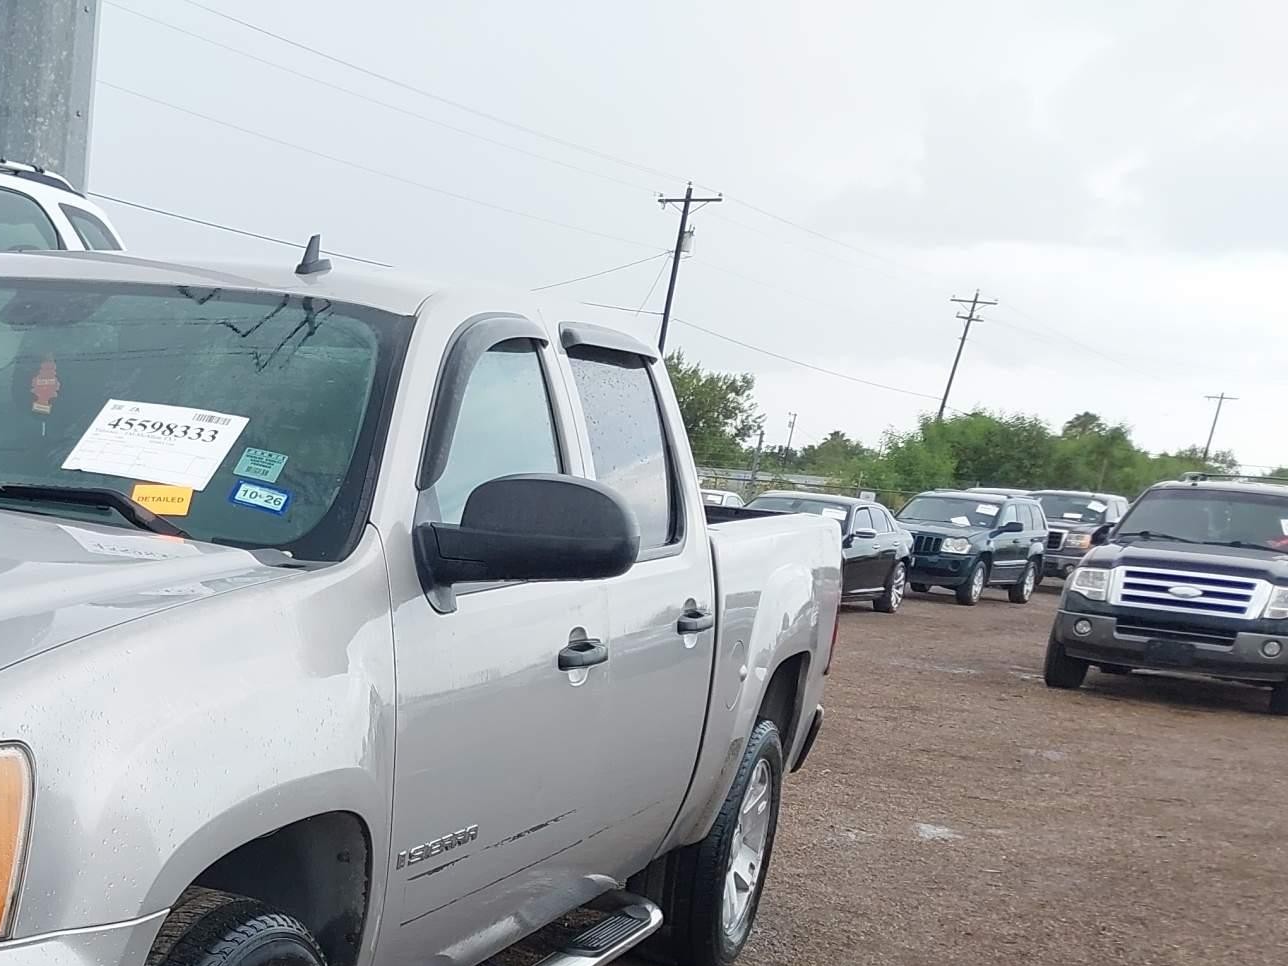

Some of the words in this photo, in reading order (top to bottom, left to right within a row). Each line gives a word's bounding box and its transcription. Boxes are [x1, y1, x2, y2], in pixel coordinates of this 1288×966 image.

[108, 416, 219, 444] 45598333
[136, 495, 185, 505] DETAILED
[407, 823, 479, 866] SIERRA
